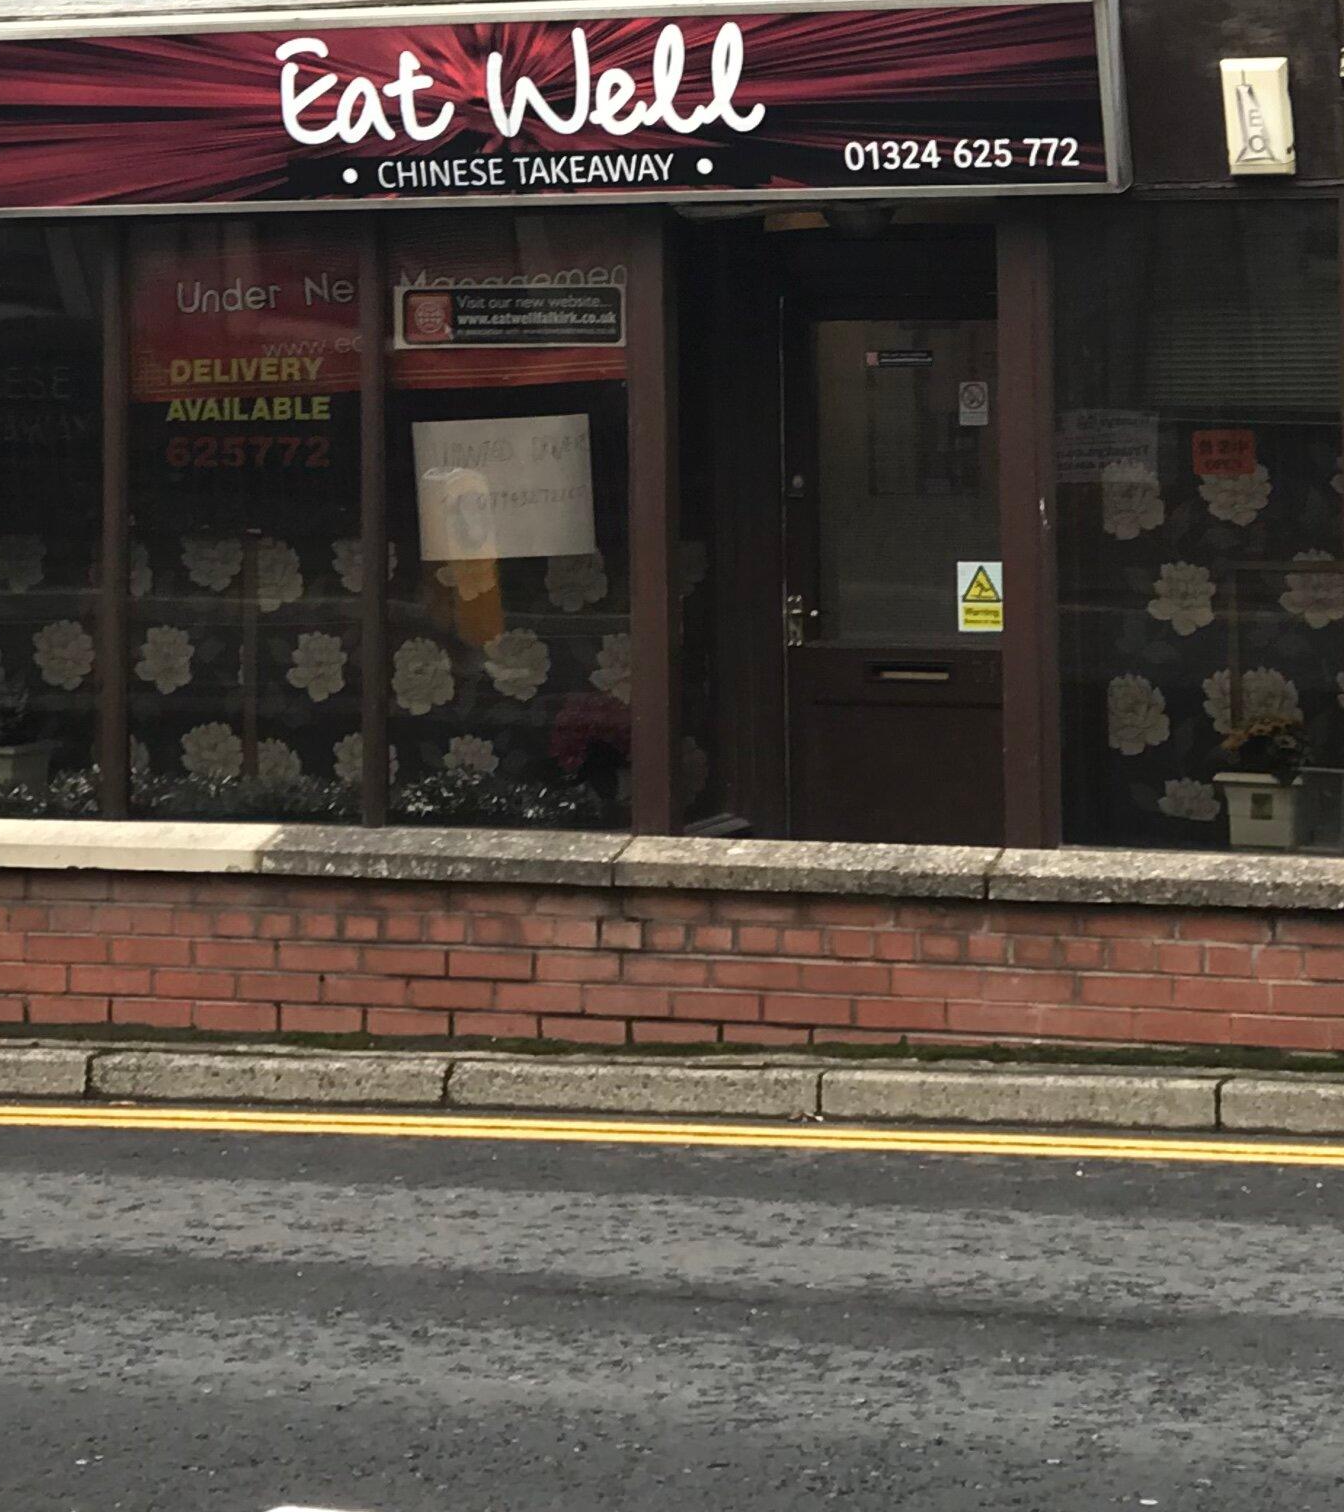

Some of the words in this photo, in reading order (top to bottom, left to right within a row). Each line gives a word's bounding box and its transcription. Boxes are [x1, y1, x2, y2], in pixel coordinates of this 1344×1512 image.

[275, 38, 455, 145] Eat
[486, 21, 766, 138] Well
[377, 157, 506, 189] CHINESE
[513, 152, 675, 186] TAKEAWAY
[844, 139, 941, 171] 01324
[953, 138, 1013, 169] 625
[1022, 136, 1081, 168] 772
[176, 277, 282, 314] Under
[304, 272, 360, 306] Ne
[516, 297, 545, 308] new
[169, 356, 326, 383] DELIVERY
[165, 395, 331, 422] AVAILABLE
[165, 436, 331, 469] 625772
